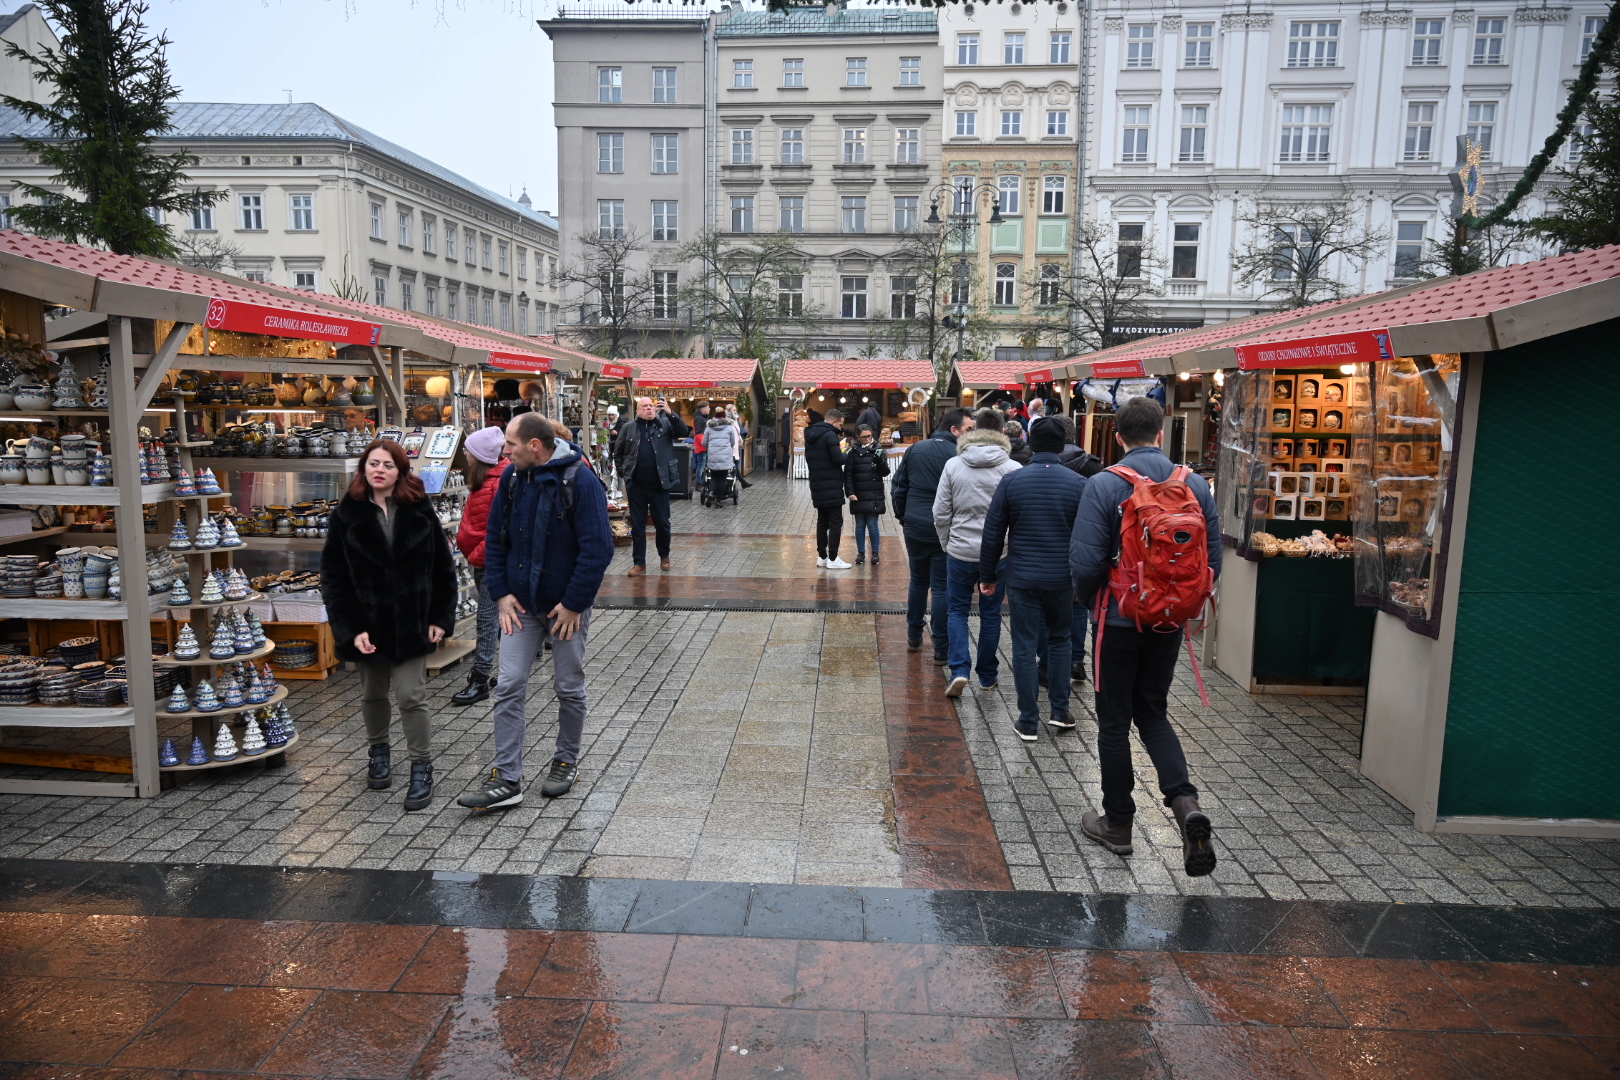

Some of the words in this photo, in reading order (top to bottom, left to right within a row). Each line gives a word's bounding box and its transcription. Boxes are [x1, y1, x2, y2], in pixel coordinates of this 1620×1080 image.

[209, 306, 222, 321] 32
[264, 315, 299, 330] CERAMIKA
[300, 321, 348, 337] BOLESŁAWIECKA
[1315, 342, 1358, 358] ŚWIĄTECZNE
[662, 389, 689, 397] PLACKI
